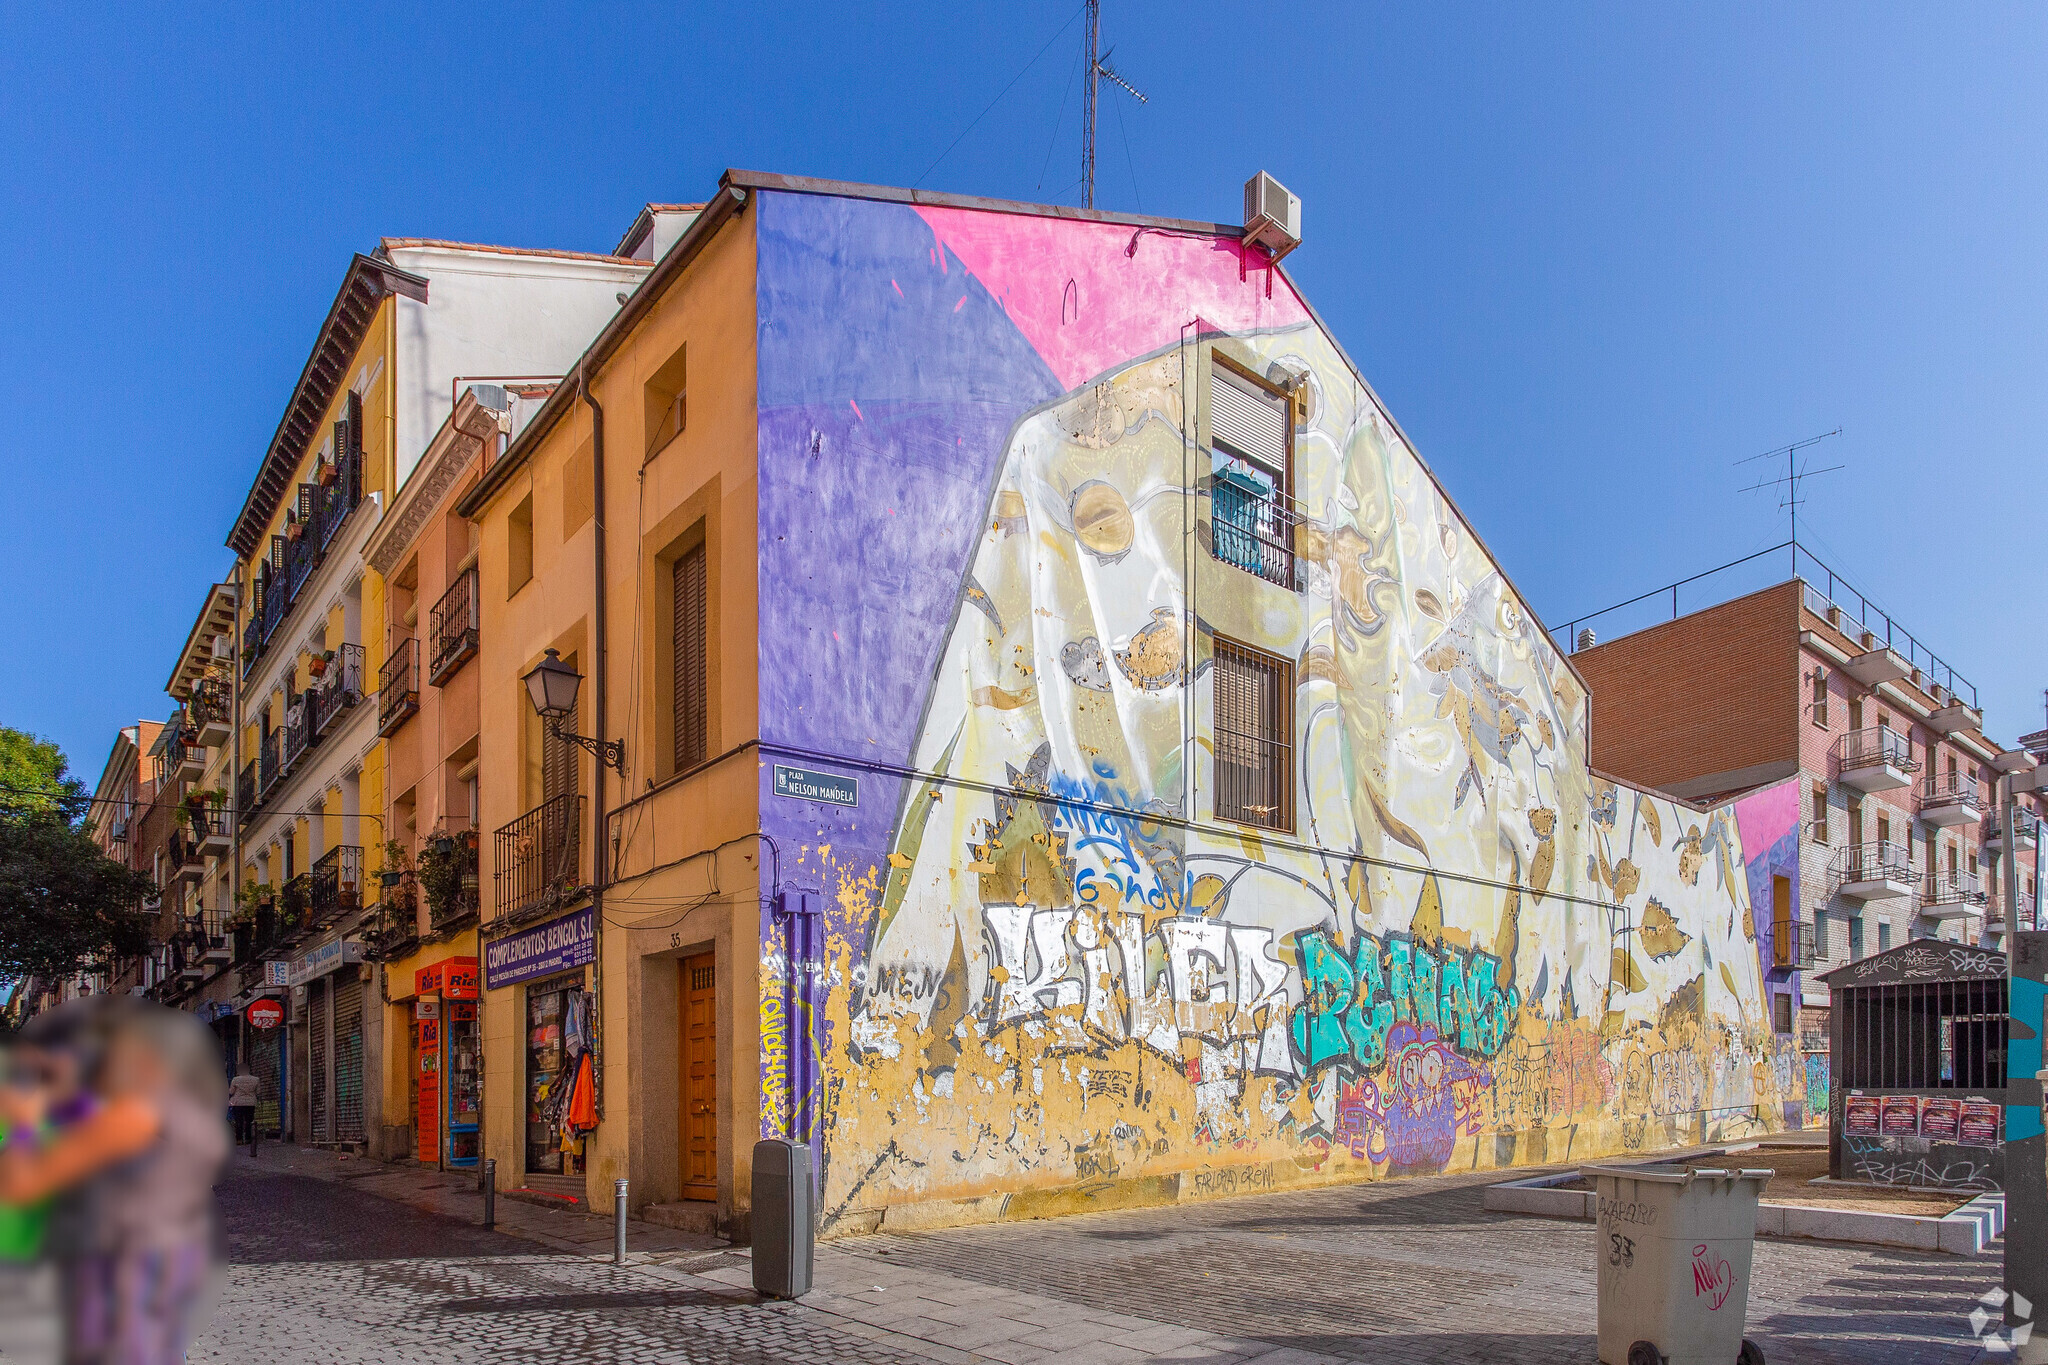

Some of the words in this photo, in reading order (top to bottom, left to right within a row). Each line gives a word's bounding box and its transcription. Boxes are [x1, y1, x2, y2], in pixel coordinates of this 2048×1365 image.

[788, 771, 804, 781] PLAZA
[788, 782, 818, 797] NELSON
[819, 786, 854, 803] MANDELA
[488, 930, 546, 969] COMPLEMENTOS
[547, 919, 579, 952] BENGOL
[670, 933, 681, 948] 35
[548, 955, 563, 968] MADRID
[421, 968, 434, 992] Ria
[449, 971, 477, 987] Ria
[422, 1020, 437, 1042] Ria
